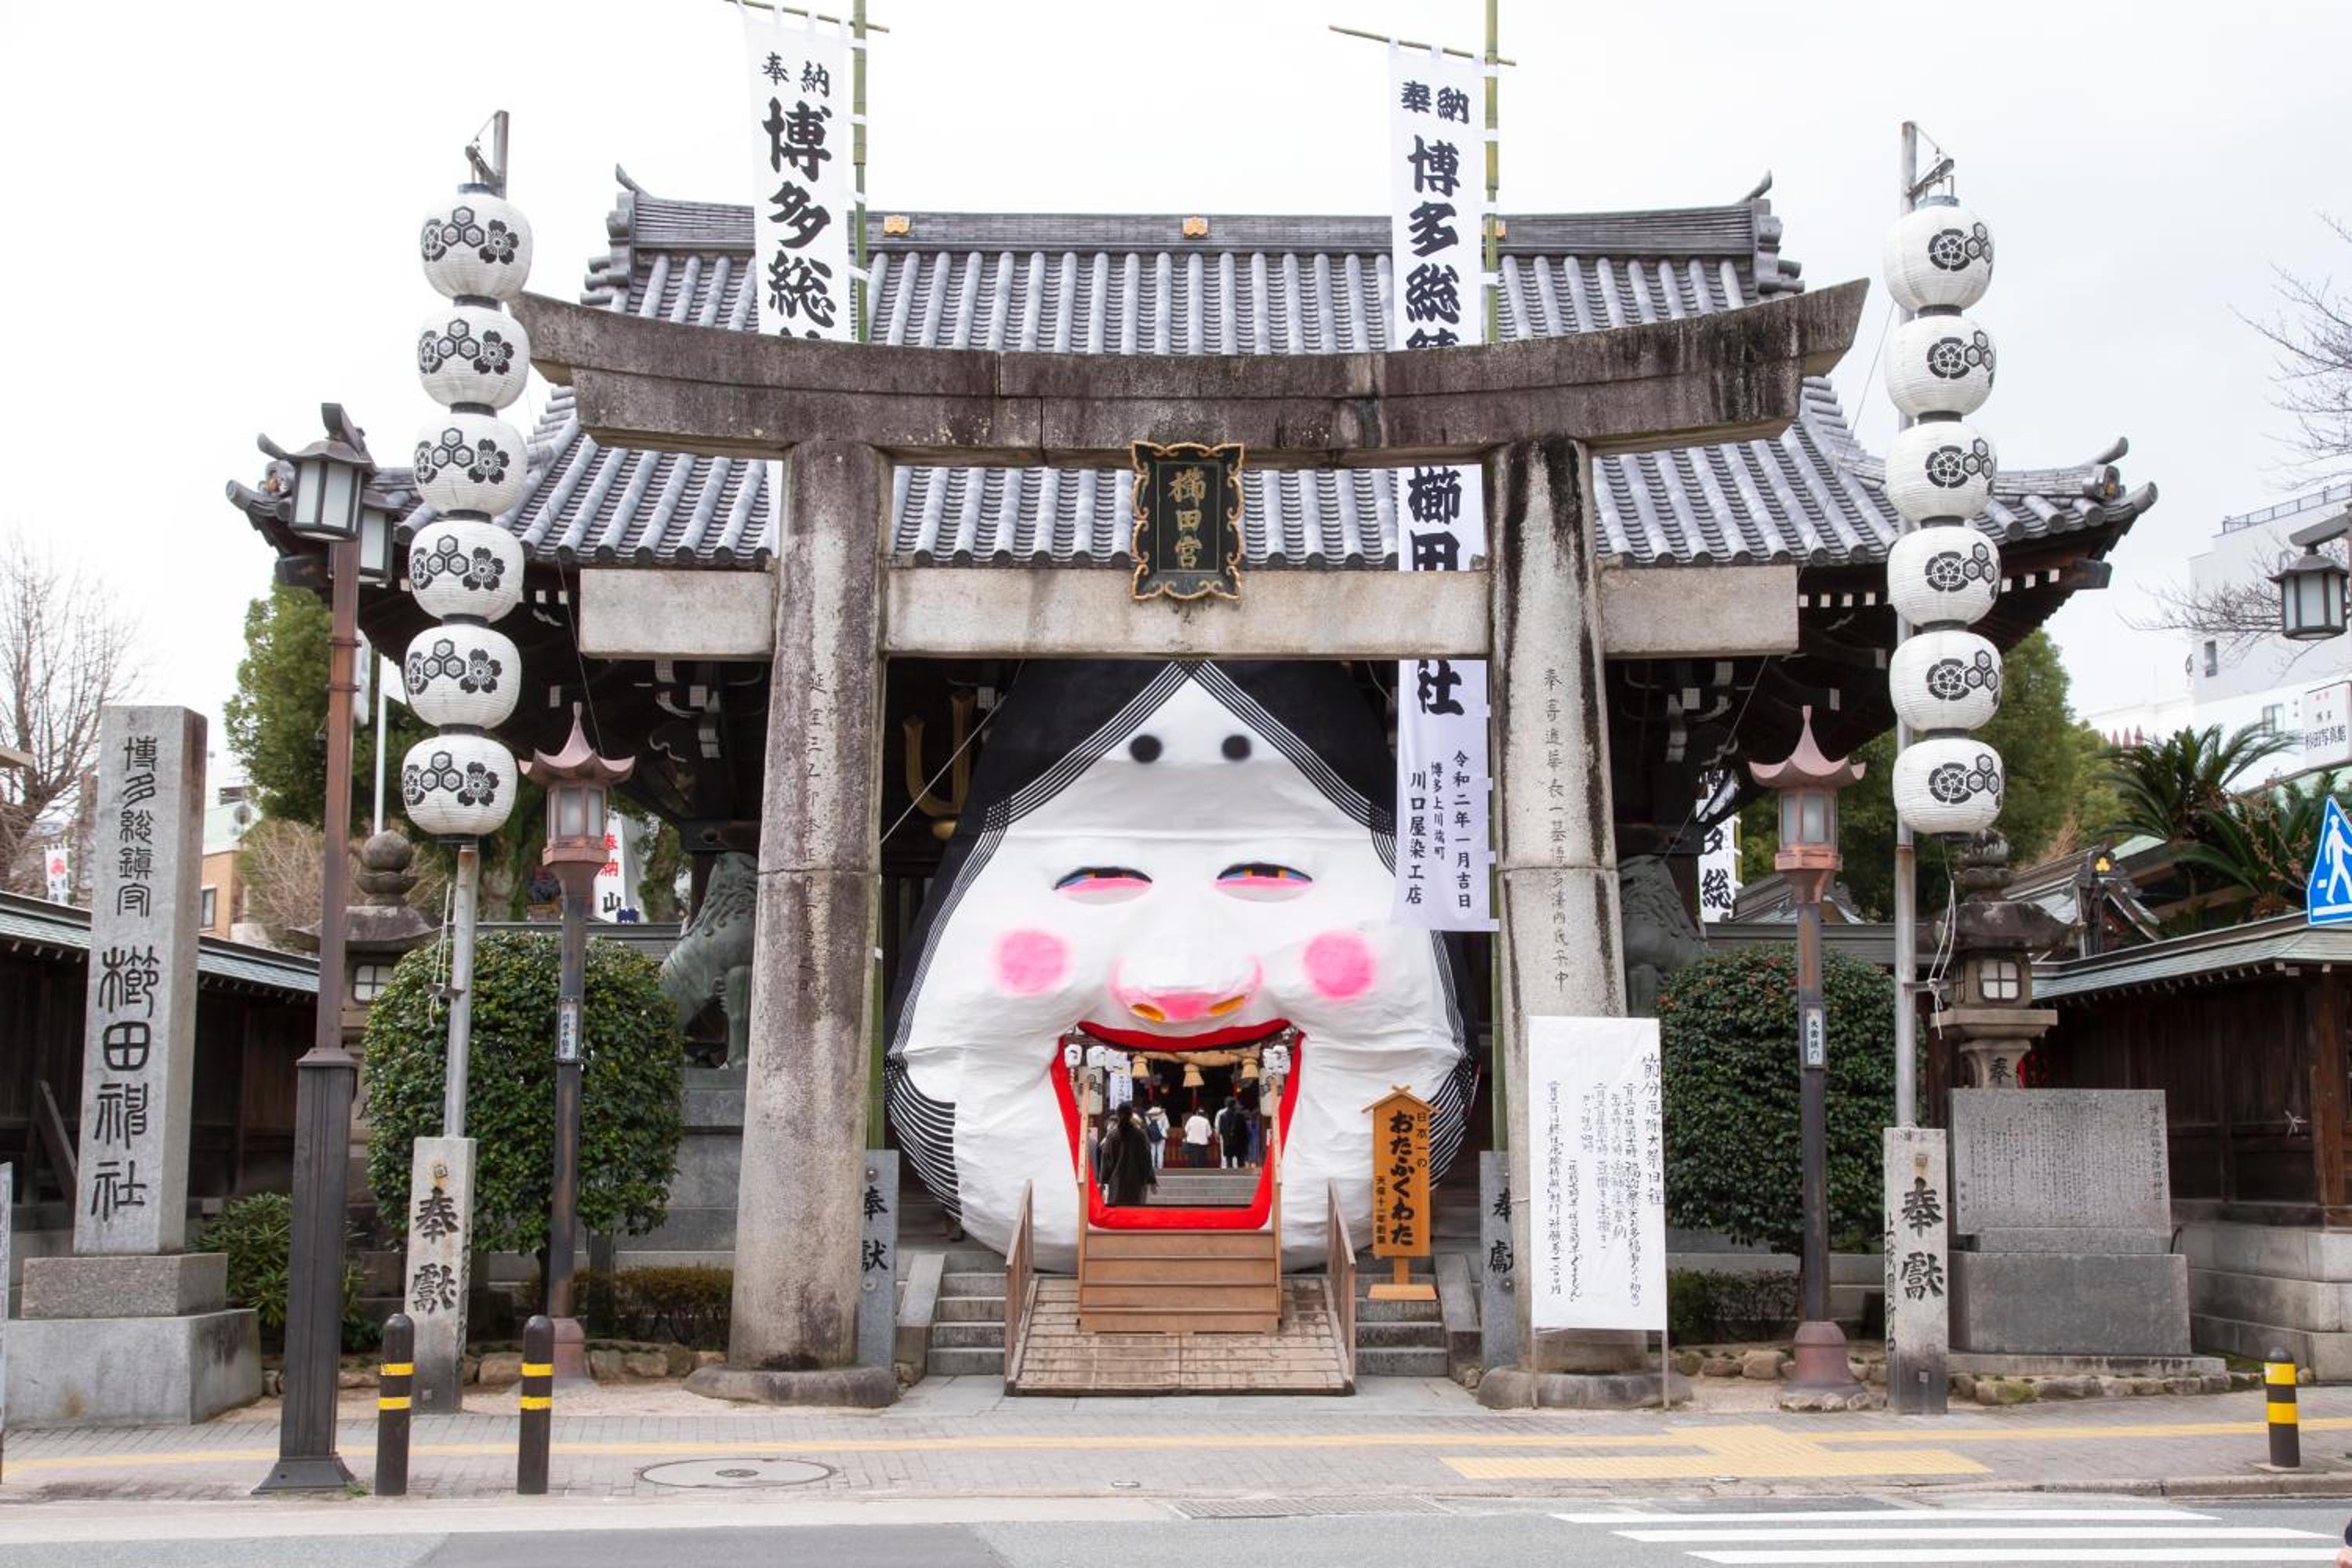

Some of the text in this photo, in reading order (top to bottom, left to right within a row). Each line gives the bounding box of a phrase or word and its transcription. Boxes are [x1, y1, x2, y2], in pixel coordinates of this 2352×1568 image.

[762, 52, 829, 97] 奉納
[1401, 80, 1470, 124] 奉納
[762, 97, 836, 339] 博多総
[1405, 771, 1426, 905] 川口屋染工店
[1453, 750, 1471, 909] 令和二年一月吉日
[1389, 1110, 1415, 1246] おたふくわた
